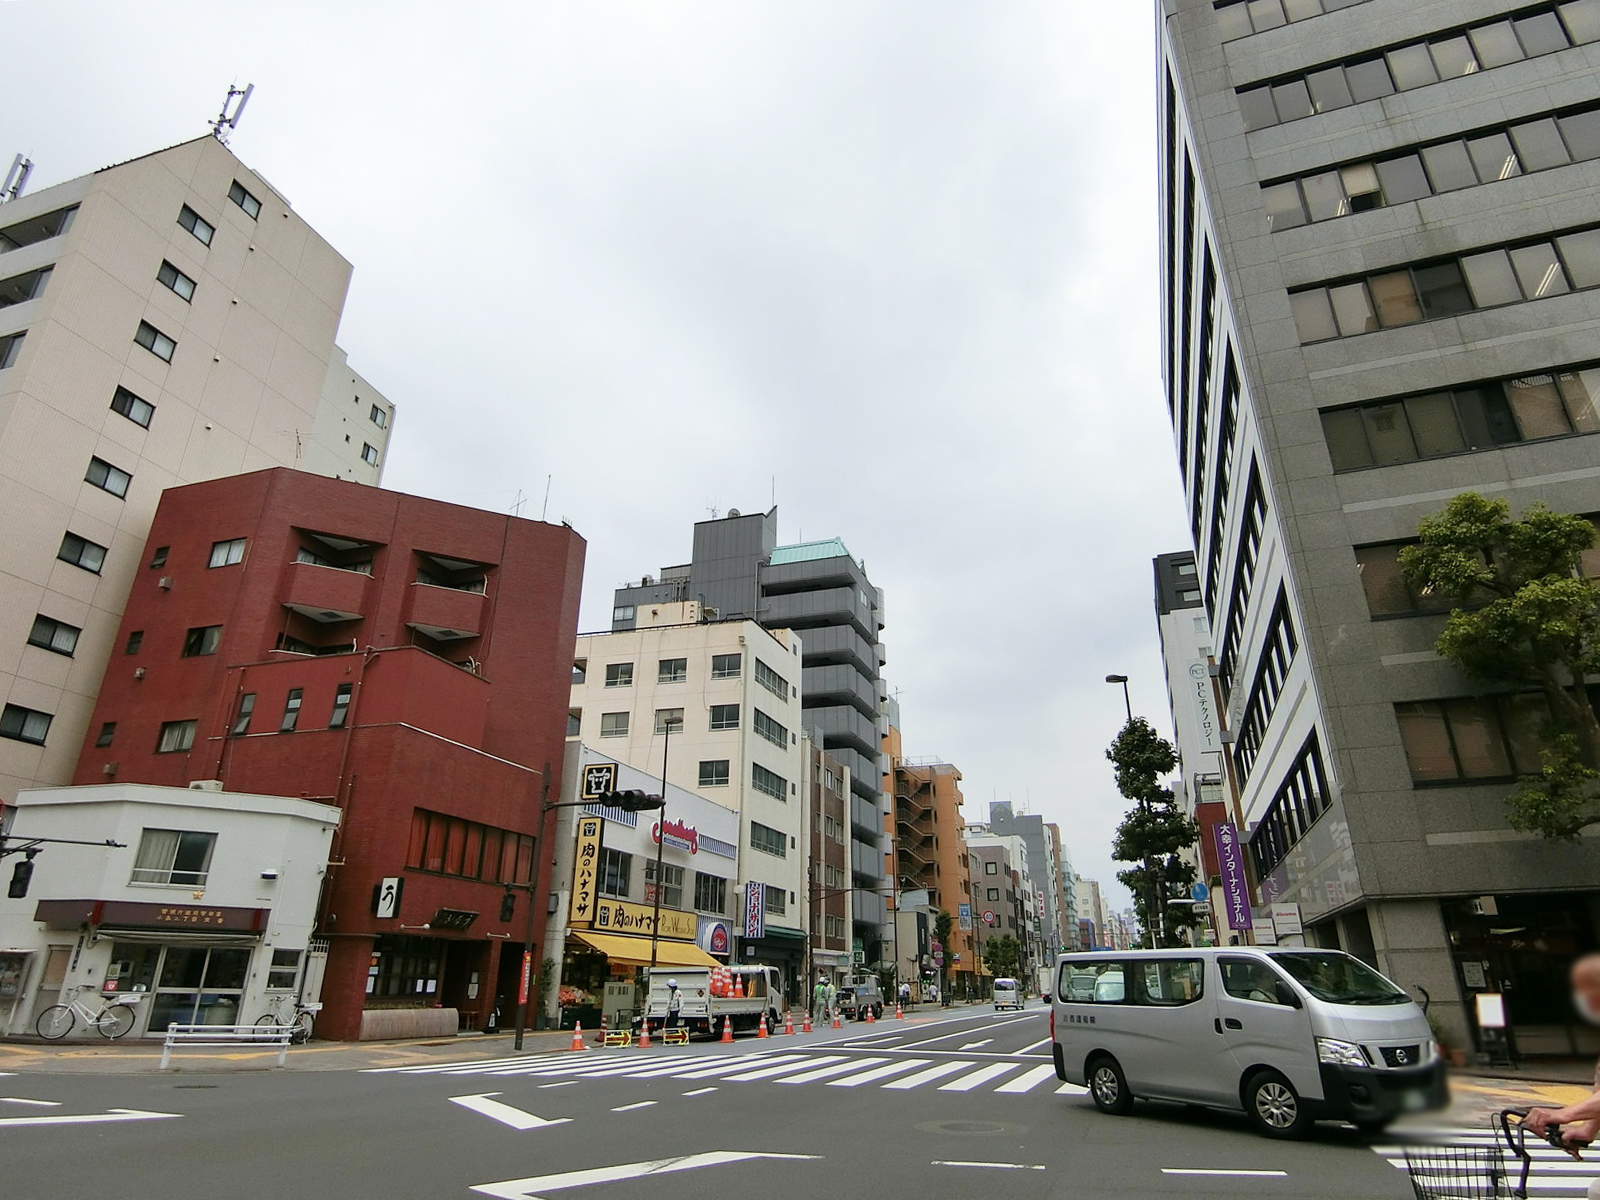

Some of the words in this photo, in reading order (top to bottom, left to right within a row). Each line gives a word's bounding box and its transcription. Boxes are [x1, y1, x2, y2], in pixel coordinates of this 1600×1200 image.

[1196, 681, 1213, 747] PCテクノロジー
[381, 884, 395, 912] う
[576, 842, 597, 918] 肉のハナマサ
[749, 886, 760, 933] ジョナサン
